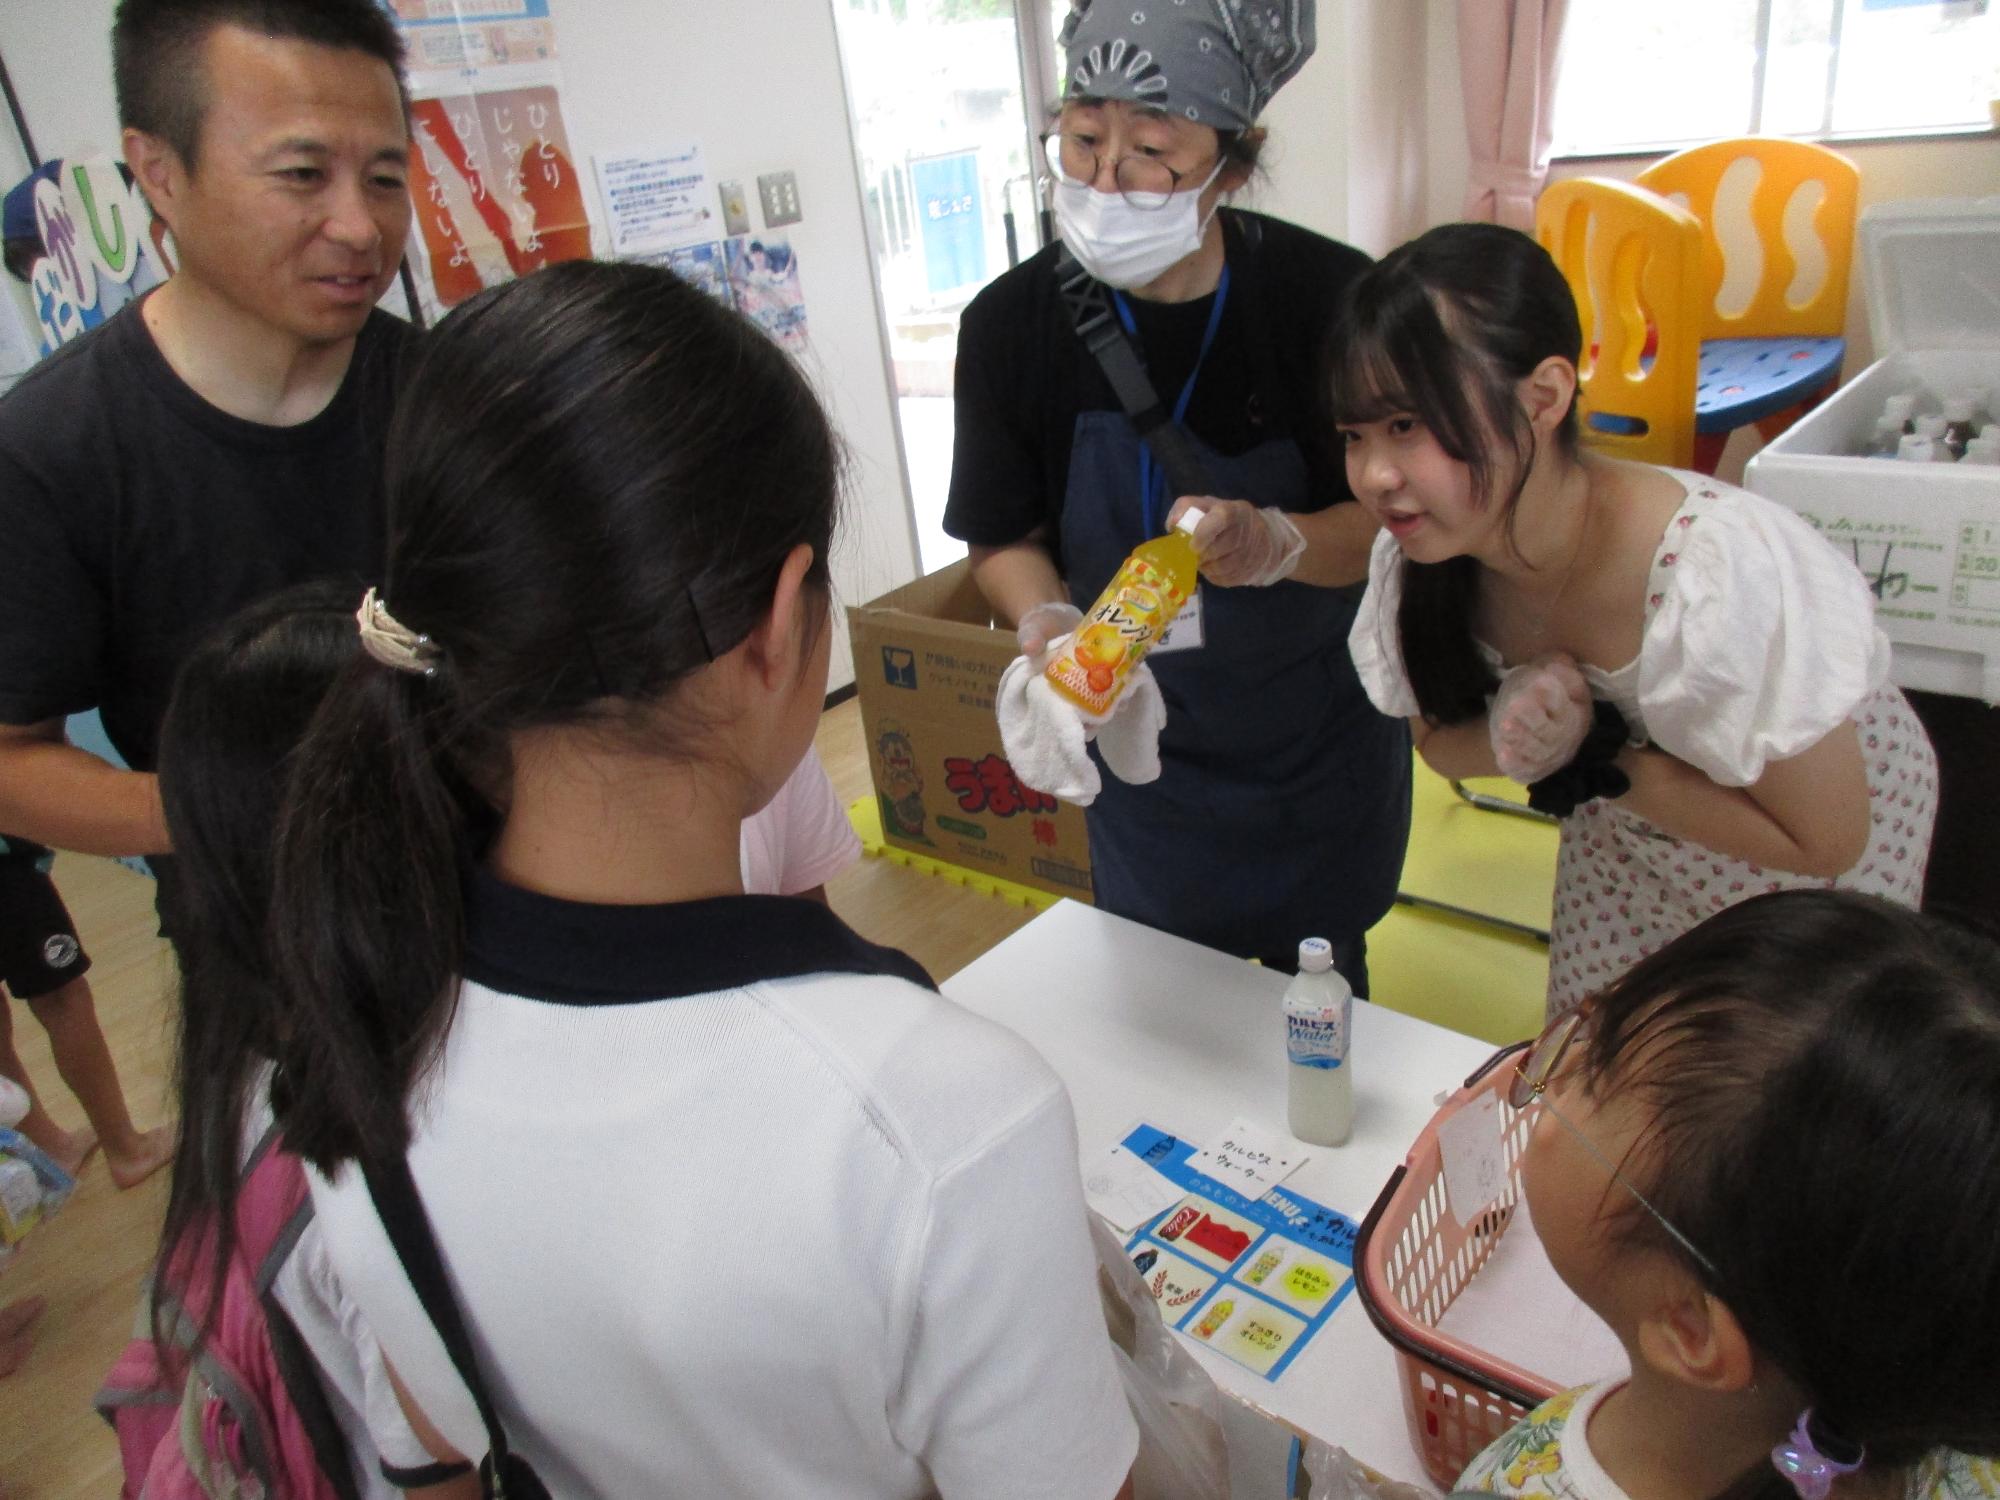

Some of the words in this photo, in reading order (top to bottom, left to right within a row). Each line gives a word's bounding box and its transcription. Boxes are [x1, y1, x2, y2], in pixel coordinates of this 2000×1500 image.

[453, 112, 487, 202] ひとり
[527, 103, 560, 190] ひとり
[1216, 1153, 1266, 1182] ウォーター
[1221, 1140, 1271, 1167] カルピス
